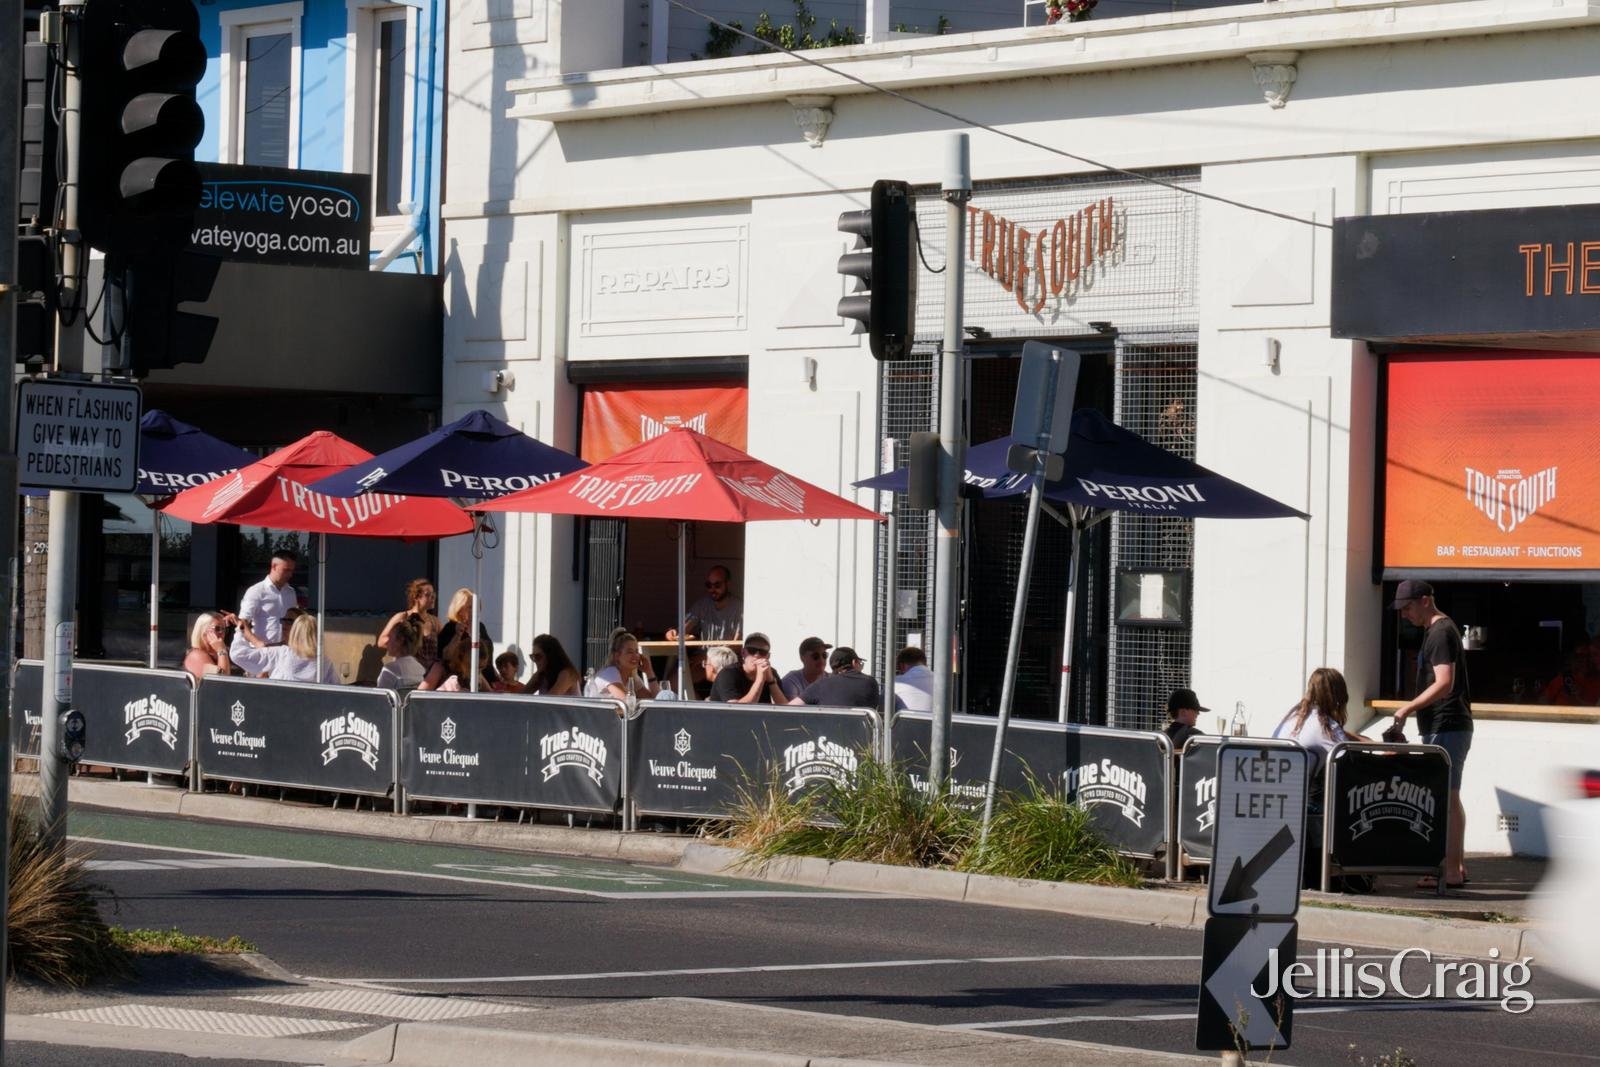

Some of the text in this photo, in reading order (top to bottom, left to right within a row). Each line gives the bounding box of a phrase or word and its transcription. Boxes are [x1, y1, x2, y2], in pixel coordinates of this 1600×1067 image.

[200, 184, 284, 213] elevate
[597, 264, 732, 295] REPAIRS
[1519, 241, 1600, 297] THE
[26, 394, 132, 421] WHEN FLASHING
[33, 423, 121, 449] GIVE WAY TO
[27, 452, 121, 478] PEDESTRIANS
[138, 468, 238, 488] PERON
[1076, 477, 1206, 503] PERONI
[1128, 502, 1177, 510] ITALIA
[1437, 546, 1582, 557] BAR RESTAURANT FUNCTIONS
[124, 694, 179, 731] True South
[210, 727, 266, 750] Veuve Clicquot
[320, 711, 380, 750] True South
[418, 746, 480, 768] Veuve Clicquot
[540, 726, 607, 767] True South
[784, 740, 816, 772] True
[648, 759, 717, 782] Veuve Clicquot
[1063, 758, 1147, 805] True South
[1235, 756, 1292, 784] KEEP
[1195, 776, 1217, 806] Tru
[1347, 775, 1435, 818] True South
[1234, 793, 1289, 819] LEFT
